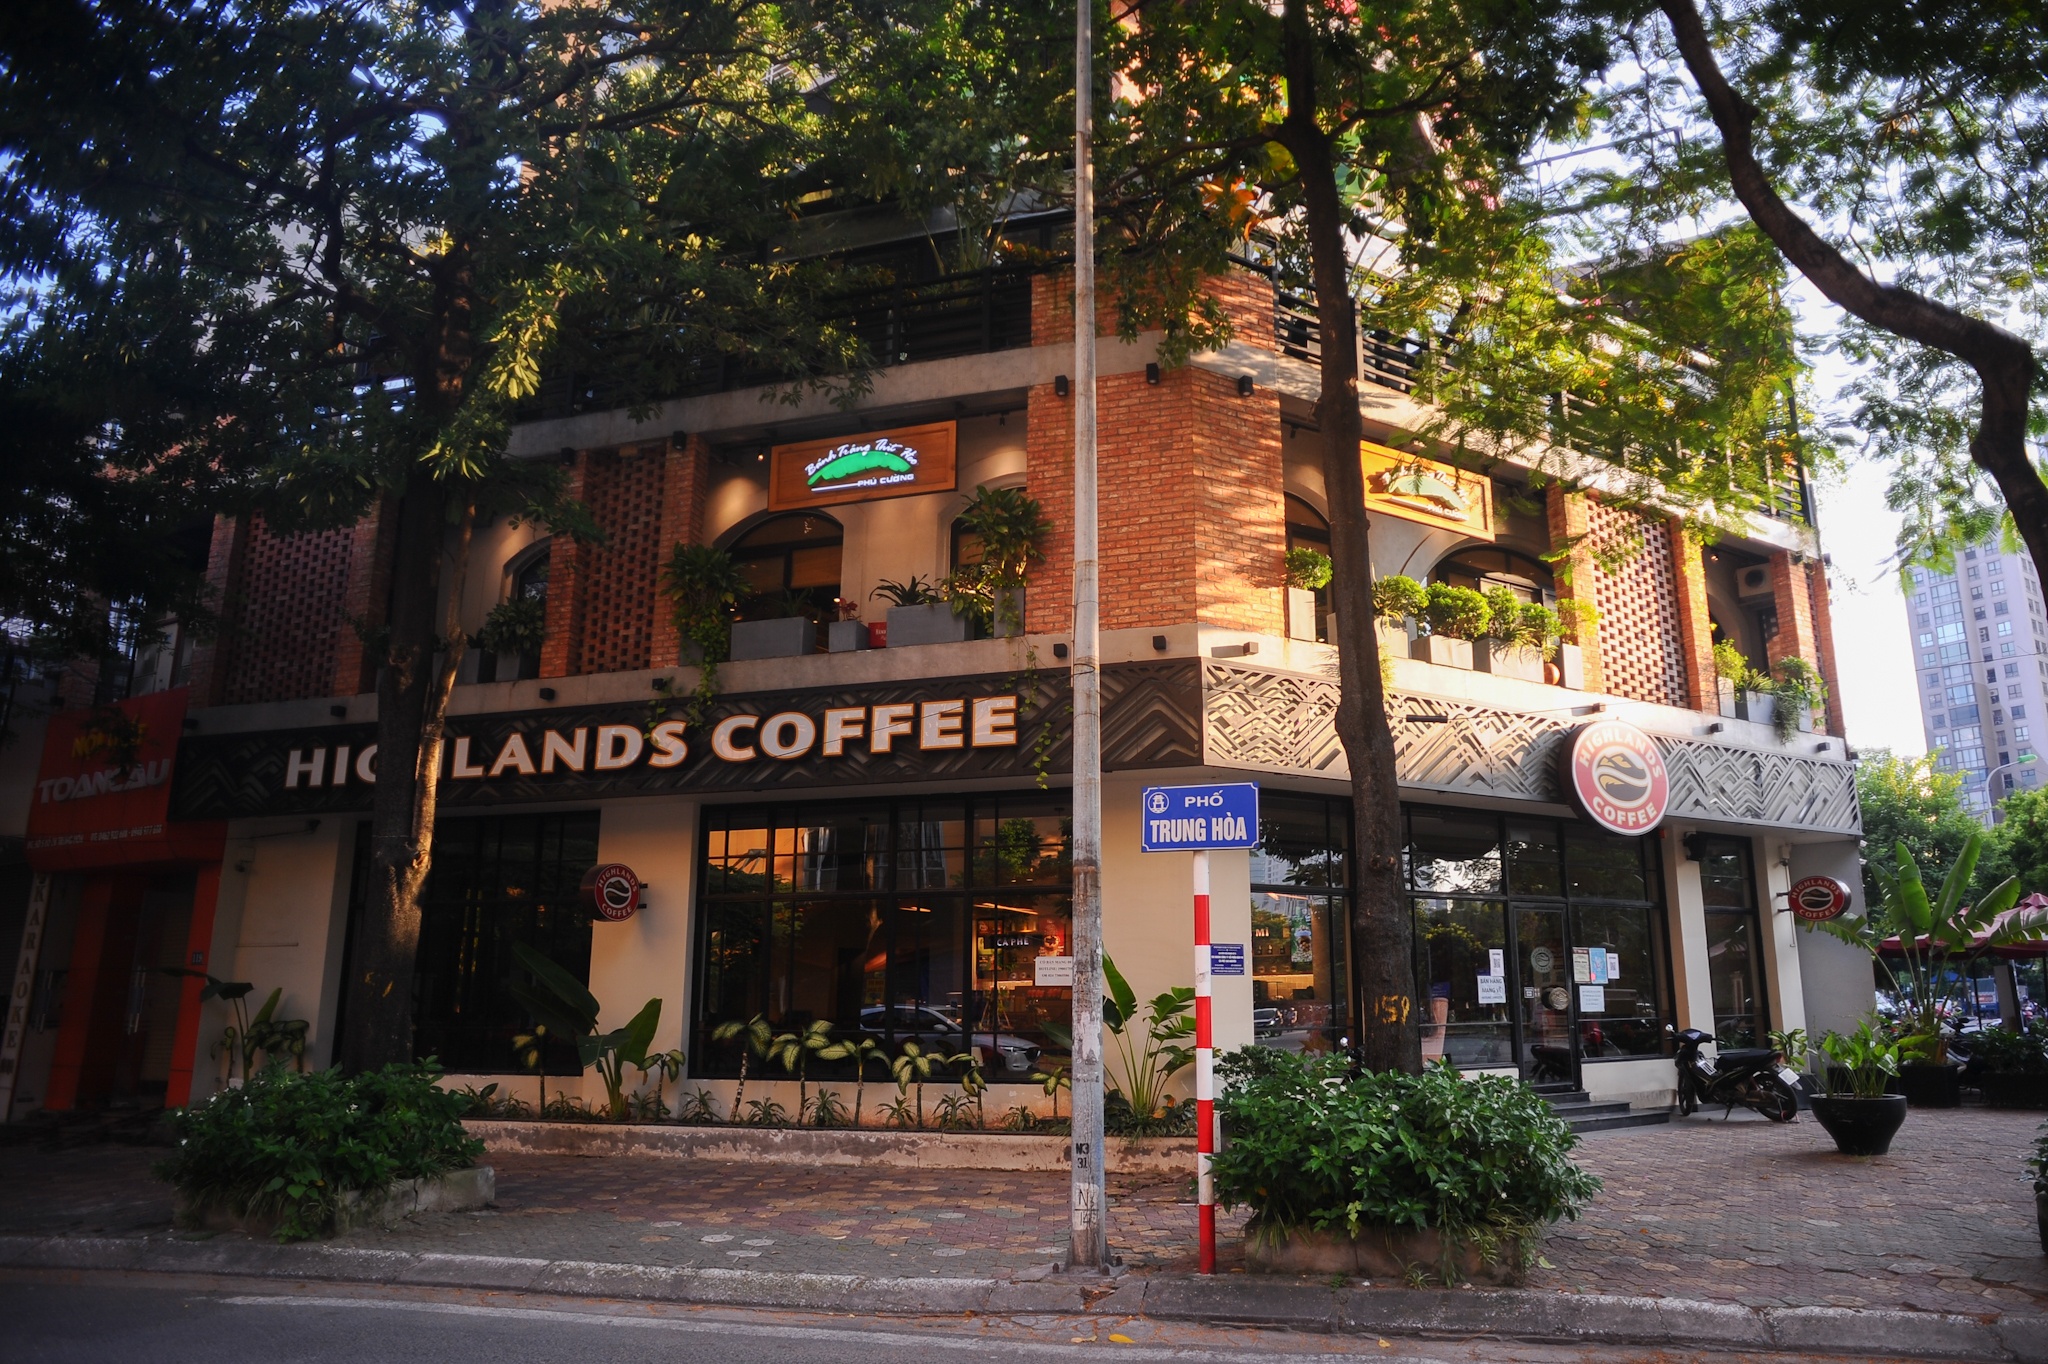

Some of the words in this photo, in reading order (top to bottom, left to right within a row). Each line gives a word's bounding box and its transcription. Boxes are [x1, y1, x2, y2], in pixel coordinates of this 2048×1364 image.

[805, 450, 837, 475] Bánh
[837, 443, 871, 458] Tráng
[875, 438, 904, 456] Thịt
[900, 447, 918, 466] Heo
[857, 477, 877, 487] PHÚ
[284, 720, 688, 789] HILANDS
[711, 695, 1018, 763] COFFEE
[1579, 728, 1662, 778] HIGHLANDS
[1184, 790, 1224, 807] PHỐ
[1593, 796, 1658, 827] COFFEE
[1150, 818, 1207, 843] TRUNG
[1211, 812, 1248, 841] HÒA
[597, 867, 638, 892] HIGHLANDS
[1791, 879, 1841, 899] HIGHLANDS
[602, 903, 632, 918] COFFEE
[1799, 905, 1837, 918] COFFEE
[7, 885, 47, 1049] KARAOKE
[1077, 1157, 1088, 1169] 31
